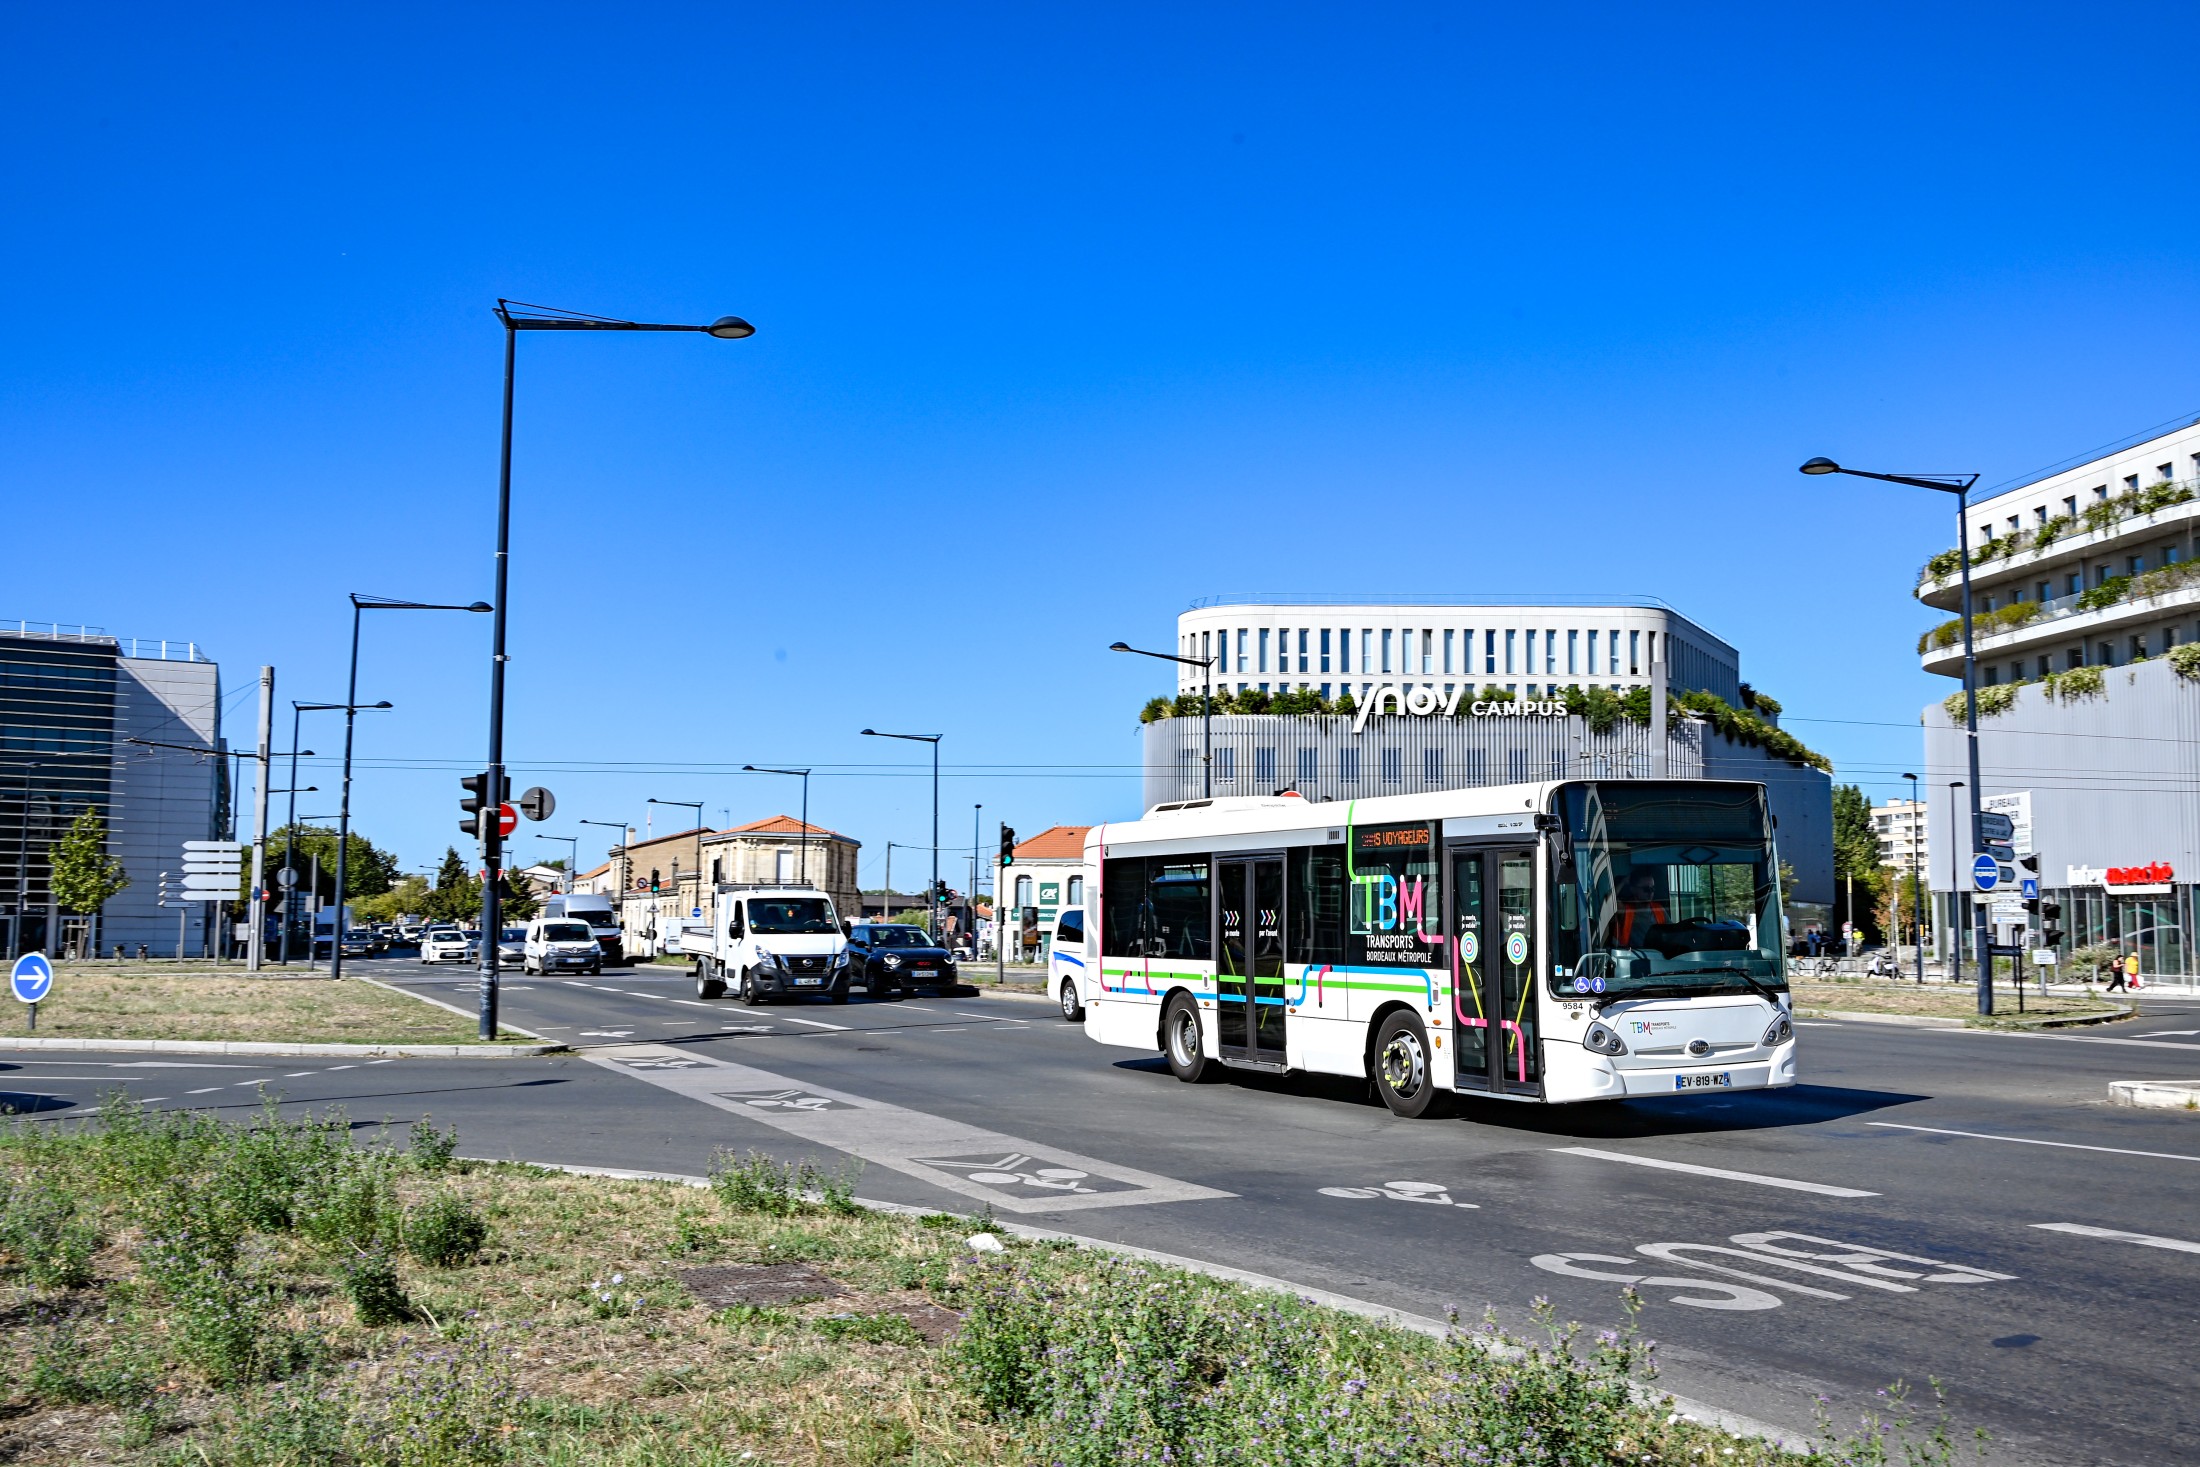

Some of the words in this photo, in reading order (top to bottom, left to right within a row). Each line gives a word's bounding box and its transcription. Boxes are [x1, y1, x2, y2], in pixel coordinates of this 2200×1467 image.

[1472, 700, 1568, 716] CAMPUS
[1989, 796, 2020, 809] BUREAUX
[1382, 829, 1430, 846] VOYAGEURS
[1355, 874, 1426, 932] TBM
[1366, 935, 1414, 949] TRANSPORTS
[1366, 951, 1396, 962] BORDEAUX
[1397, 950, 1432, 963] MÉTROPOLE
[1562, 1002, 1584, 1010] 9584
[1629, 1021, 1653, 1035] TBM
[1681, 1074, 1724, 1087] EV-819-WZ
